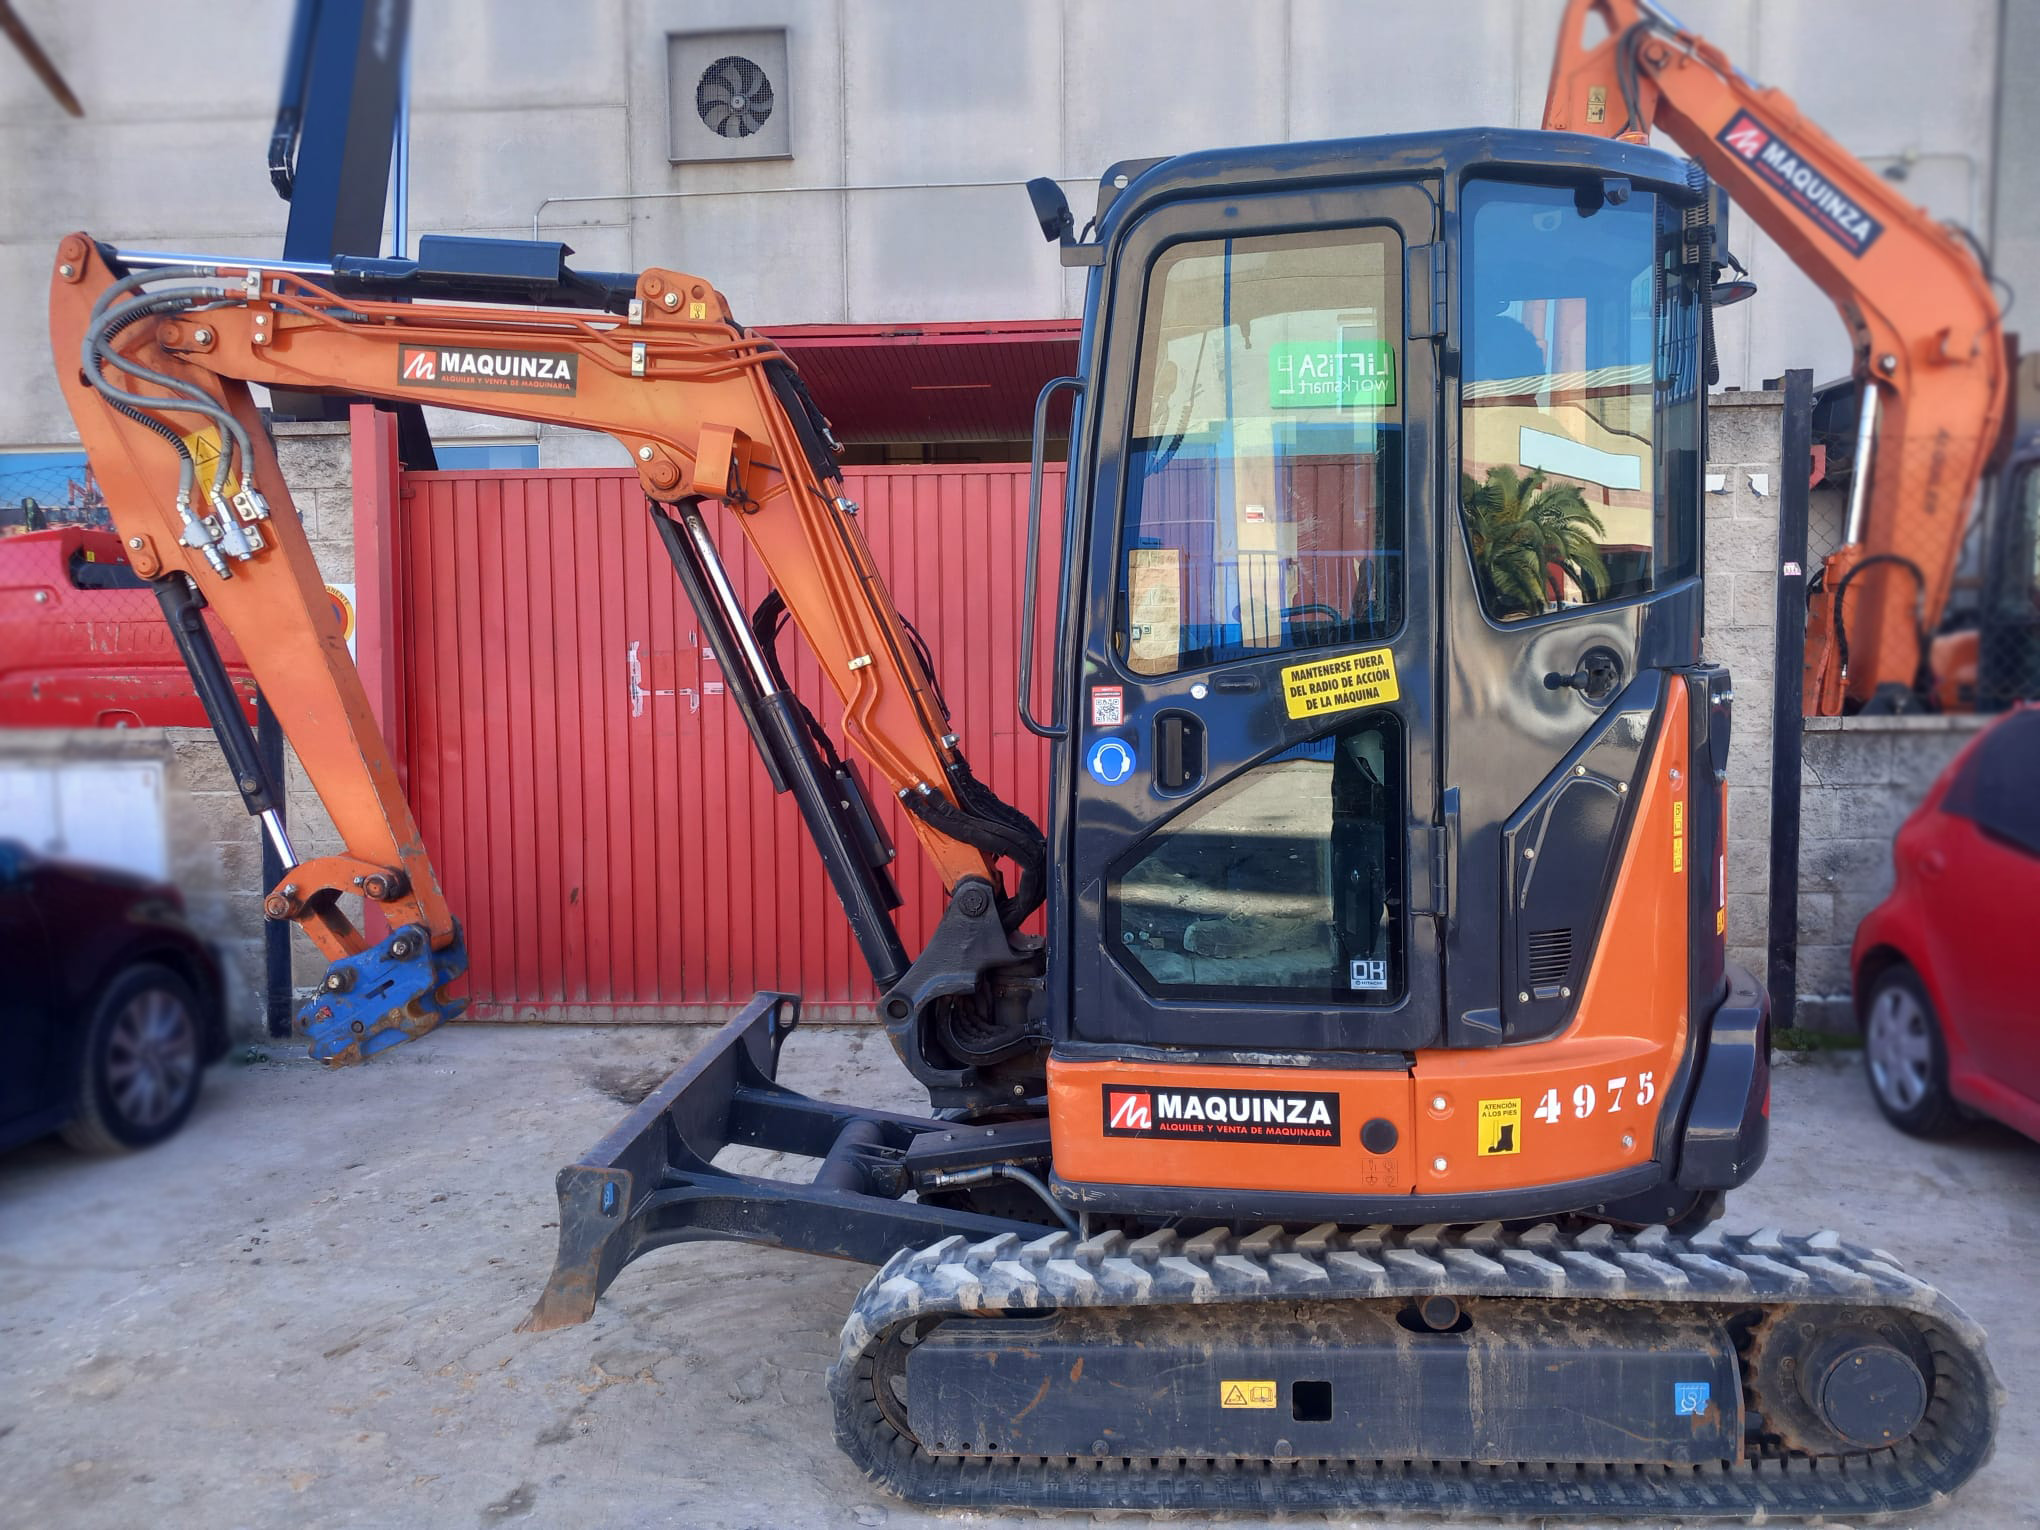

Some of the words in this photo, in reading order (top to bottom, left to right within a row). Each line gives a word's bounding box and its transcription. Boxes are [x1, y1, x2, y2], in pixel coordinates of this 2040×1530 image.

[1761, 142, 1871, 242] MAQUINZA
[441, 352, 571, 380] MAQUINZA
[441, 375, 475, 384] ALQUILER
[484, 378, 507, 386] VENTA
[510, 379, 519, 387] DE
[521, 381, 571, 390] MAQUINARIA
[1291, 660, 1352, 682] MANTENERSE
[1353, 654, 1385, 670] FUERA
[1290, 684, 1307, 698] DEL
[1309, 678, 1339, 695] RADIO
[1341, 675, 1354, 688] DE
[1356, 667, 1391, 686] ACCIÓN
[1305, 698, 1319, 711] DE
[1320, 695, 1332, 708] LA
[1334, 688, 1380, 706] MÁQUINA
[1352, 962, 1385, 980] OK
[1157, 1094, 1332, 1125] MAQUINZA
[1484, 1101, 1517, 1111] ATENCIÓN
[1488, 1110, 1501, 1118] LOS
[1159, 1123, 1204, 1133] ALQUILER
[1208, 1125, 1215, 1133] Y
[1216, 1125, 1248, 1135] VENTA
[1251, 1126, 1263, 1135] DE
[1265, 1127, 1333, 1138] MAQUINARIA
